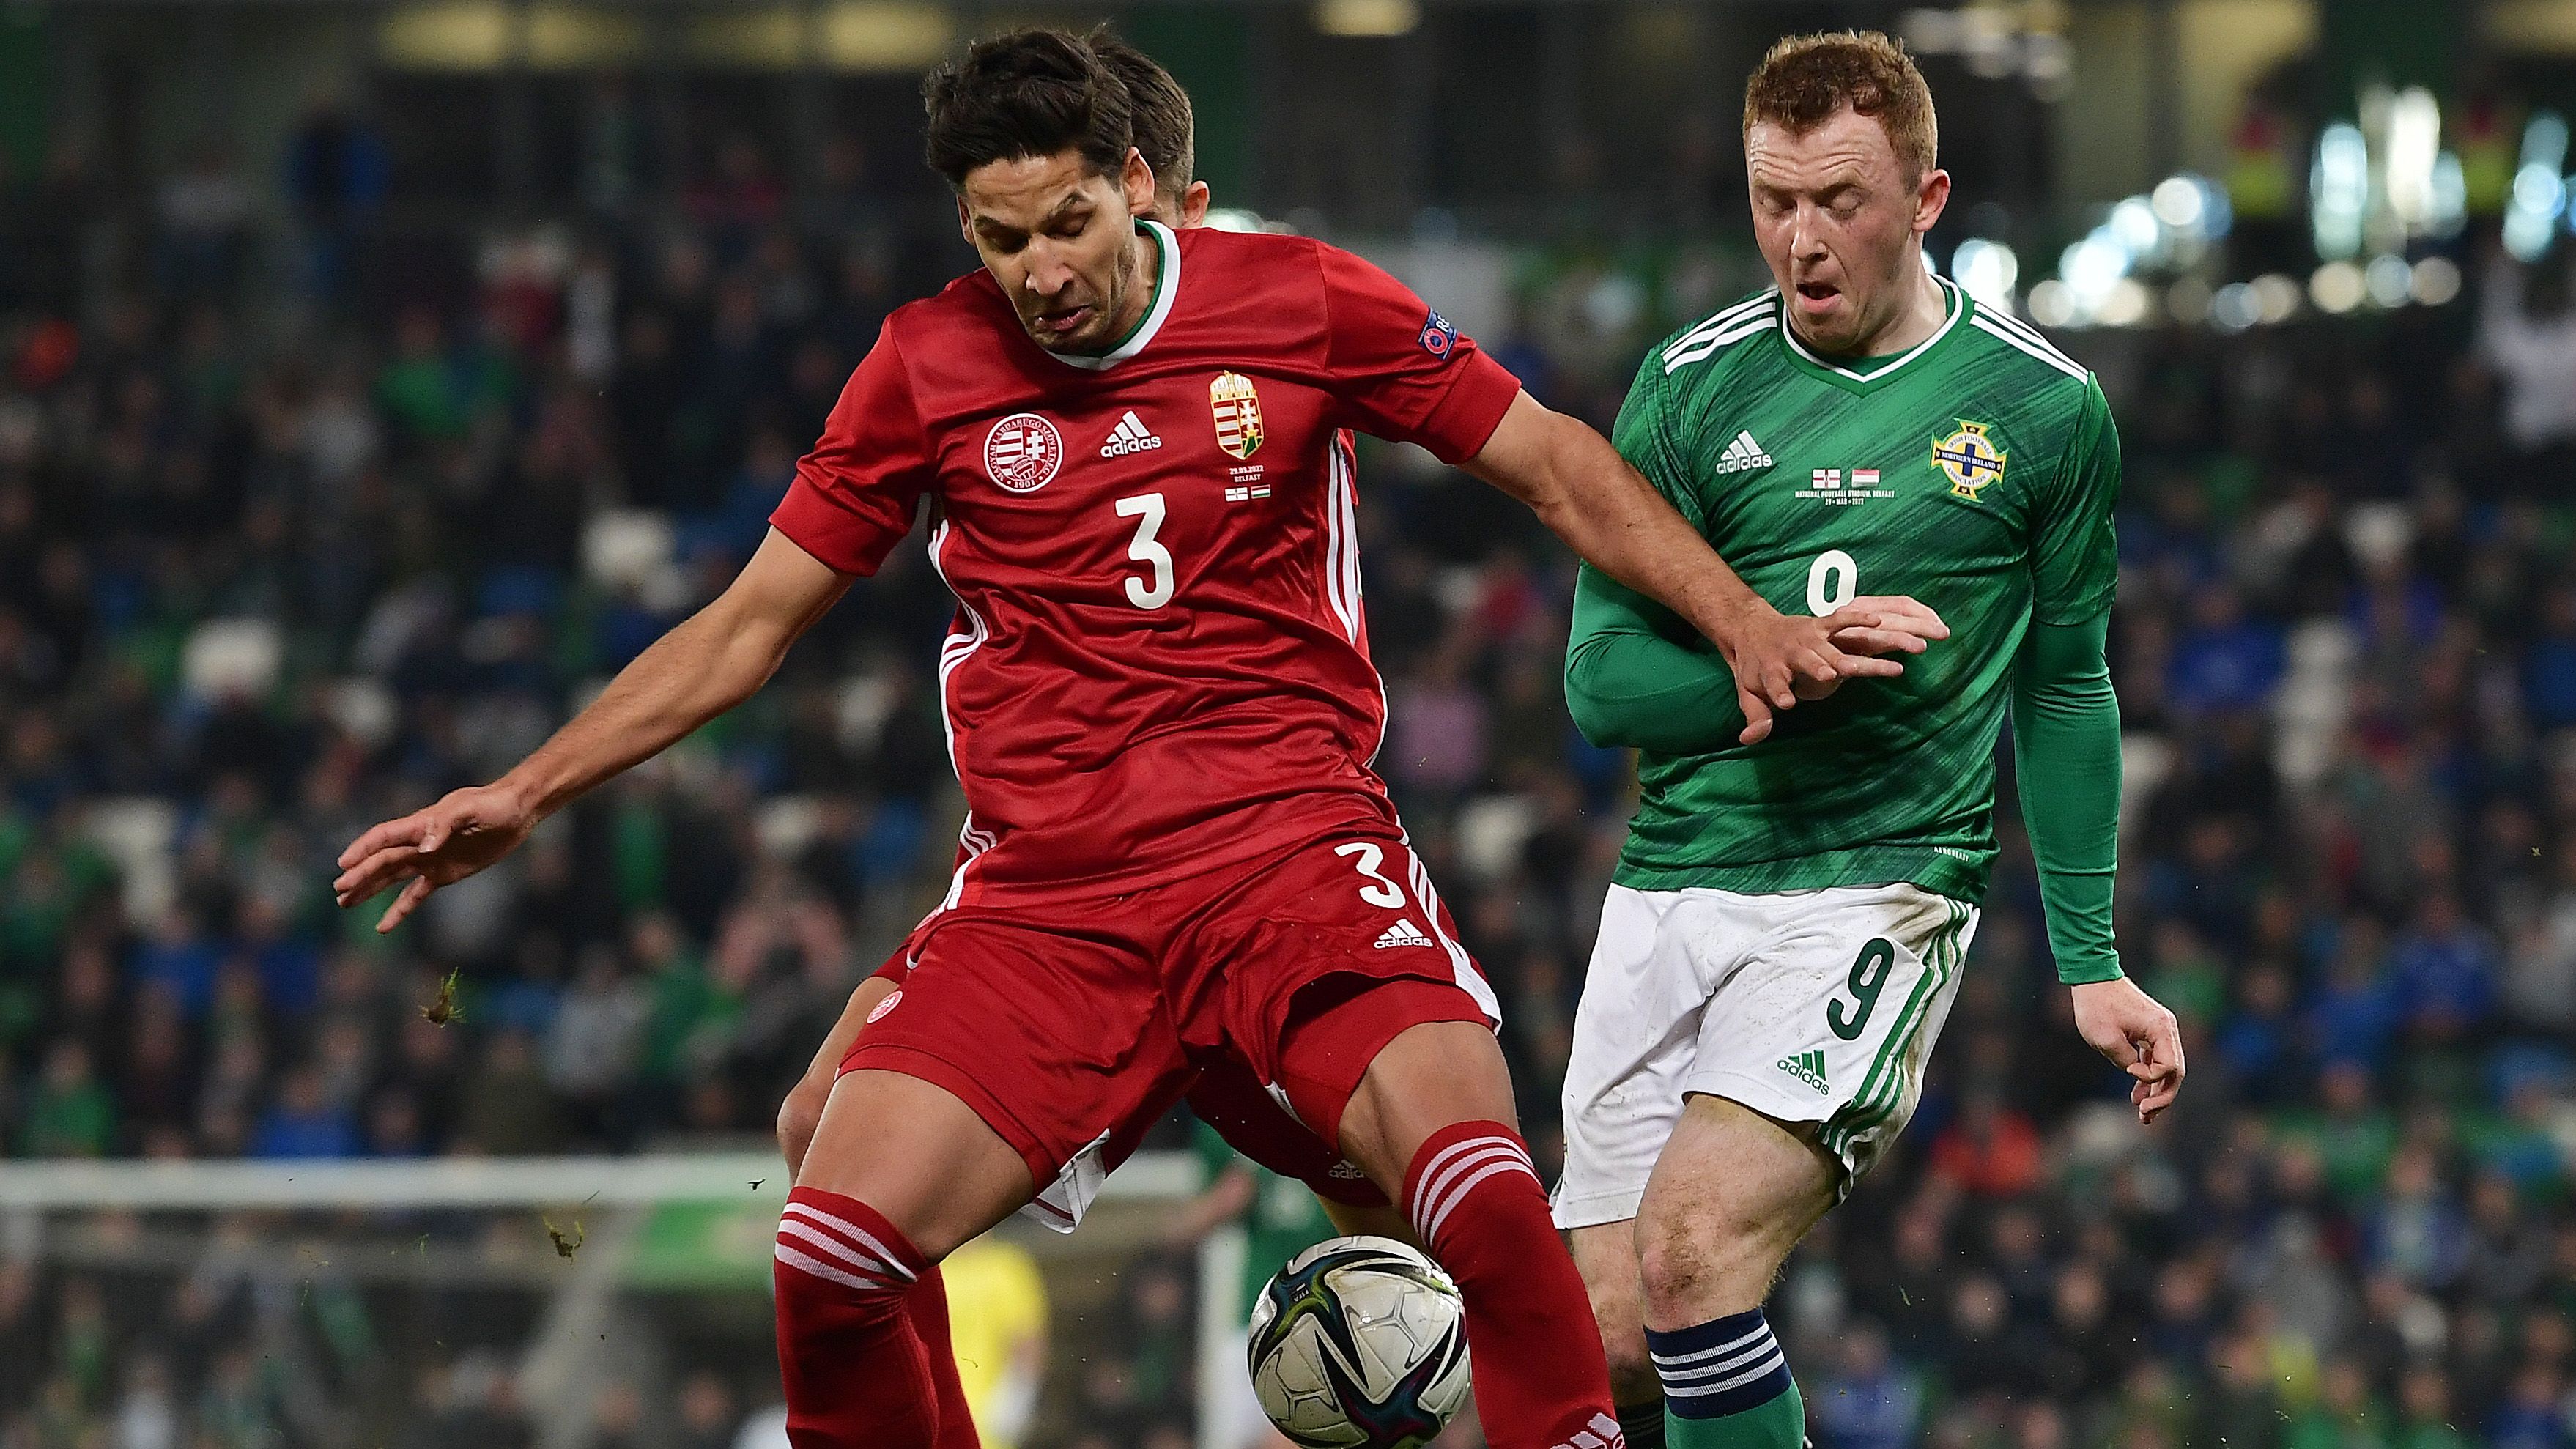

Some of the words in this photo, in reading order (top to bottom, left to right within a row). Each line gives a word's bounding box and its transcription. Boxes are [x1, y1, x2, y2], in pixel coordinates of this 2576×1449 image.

[1100, 435, 1162, 458] adidas
[1964, 435, 1993, 455] FOOTBALL
[990, 445, 1005, 482] MAGYAR
[1716, 453, 1772, 475] adidas
[1941, 452, 1972, 463] NORTHERN
[1972, 456, 1996, 469] IRELAND
[1014, 480, 1036, 489] 1901
[1234, 473, 1261, 483] BELFAST
[1946, 467, 1987, 485] ASSOCIATION
[1795, 490, 1820, 498] NATIONAL
[1821, 490, 1846, 498] FOOTBALL
[1872, 490, 1895, 498] BELFAST
[1114, 492, 1174, 609] 3
[1334, 842, 1406, 908] 3
[1374, 937, 1433, 949] adidas
[1826, 936, 1895, 1041] 9
[1777, 1059, 1830, 1096] adidas
